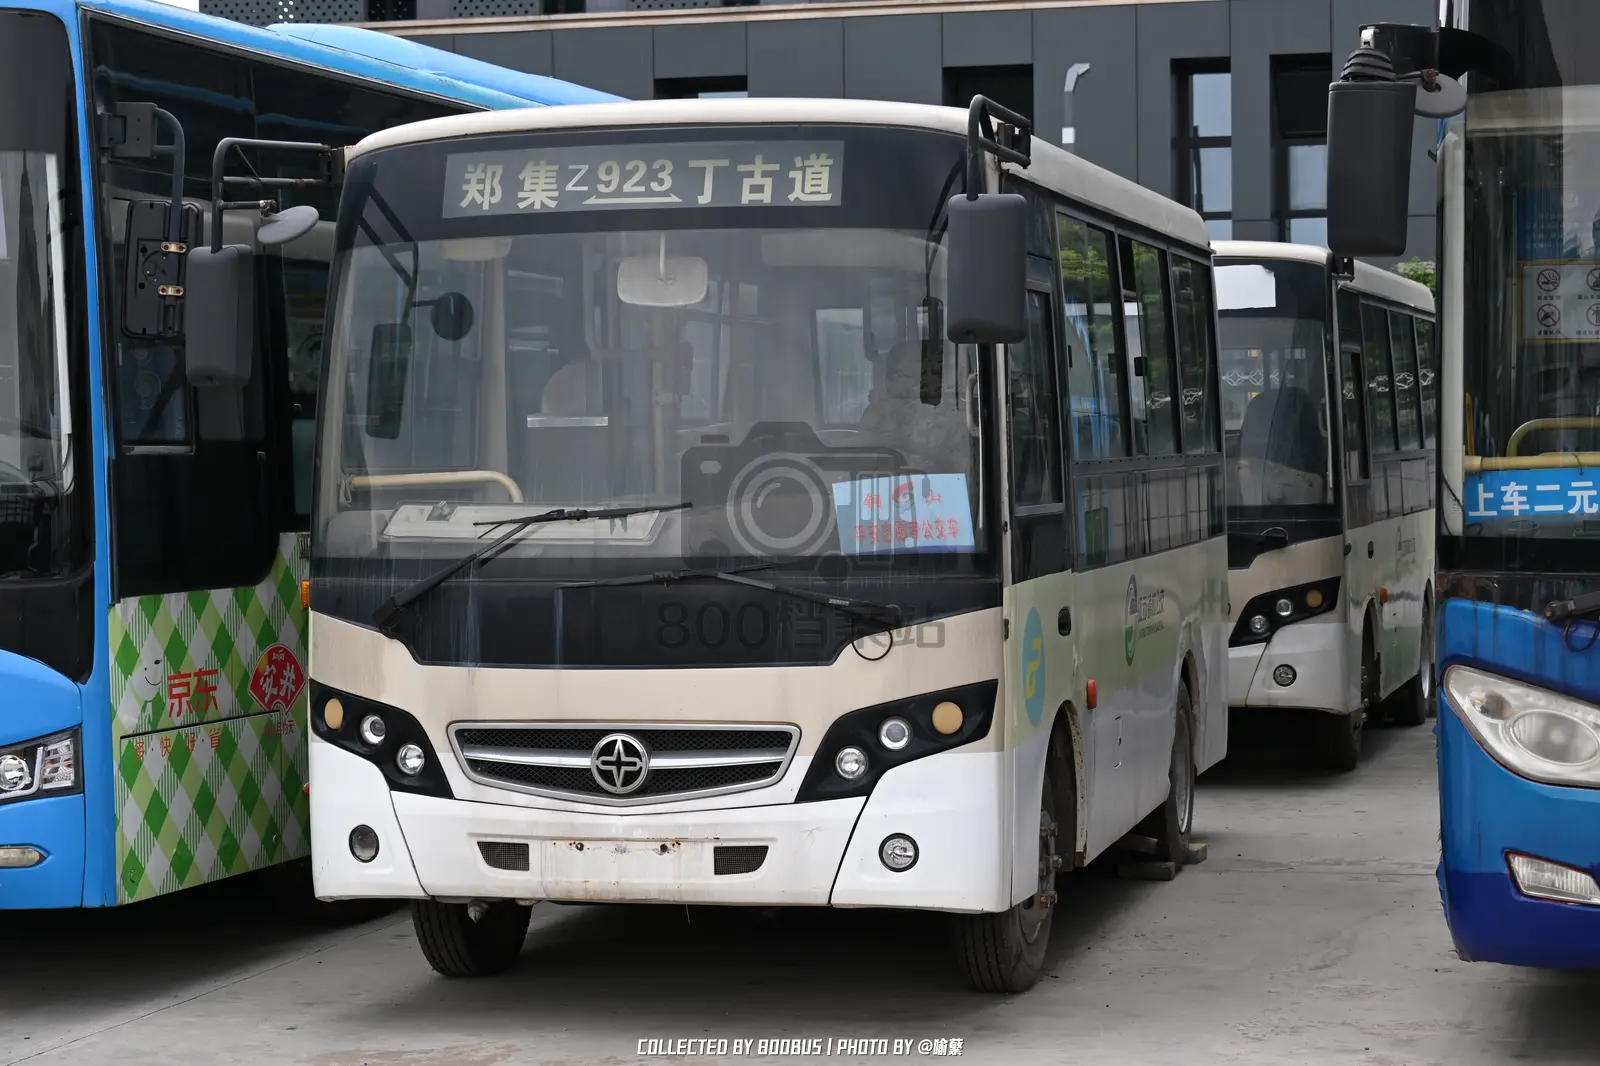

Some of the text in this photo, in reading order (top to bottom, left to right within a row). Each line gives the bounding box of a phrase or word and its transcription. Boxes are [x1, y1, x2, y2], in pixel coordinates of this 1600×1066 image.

[460, 152, 834, 210] 郑集 Z923 丁古道
[1469, 481, 1599, 516] 上车二元
[167, 667, 219, 718] 京东
